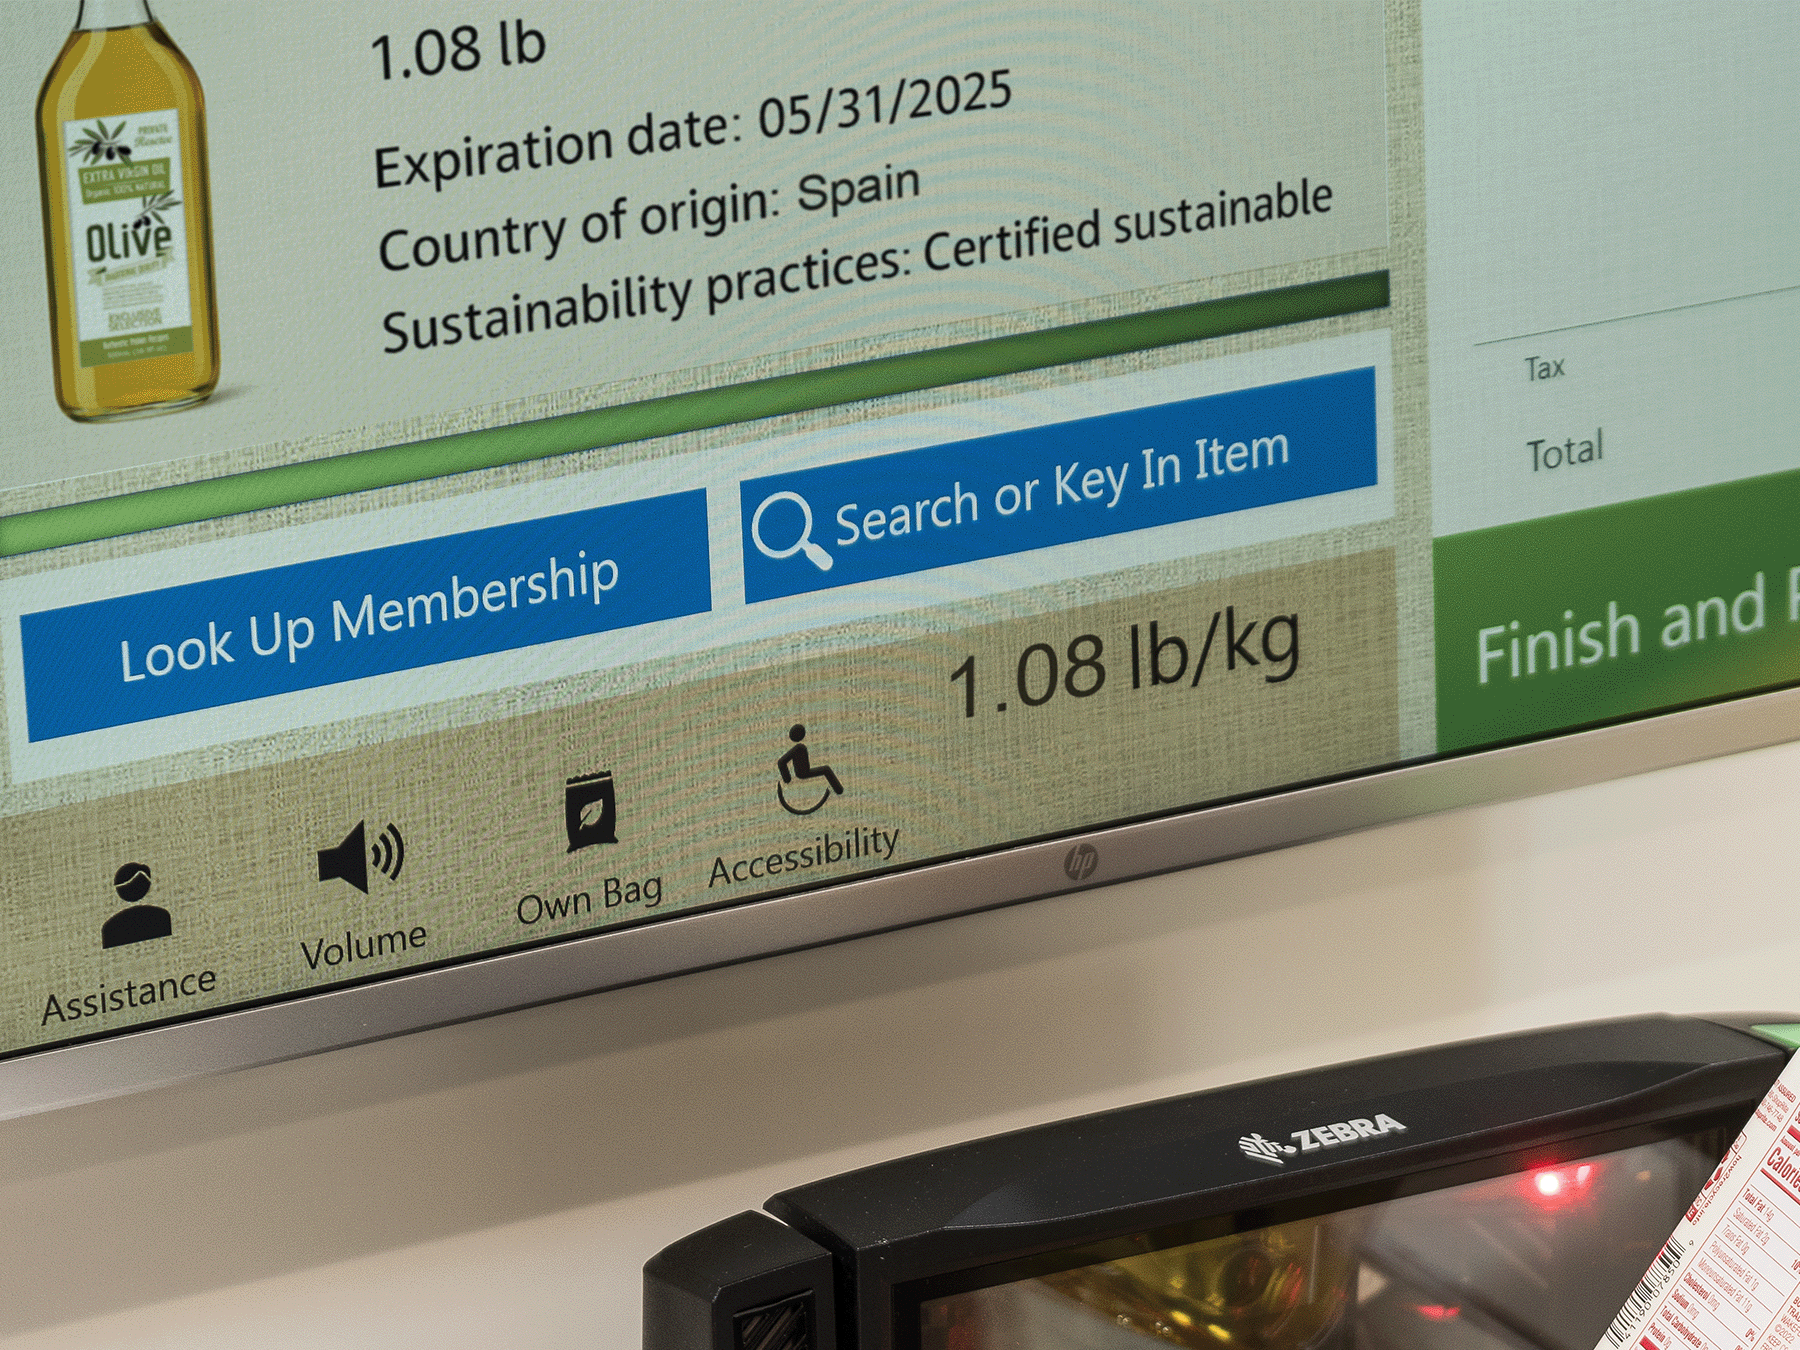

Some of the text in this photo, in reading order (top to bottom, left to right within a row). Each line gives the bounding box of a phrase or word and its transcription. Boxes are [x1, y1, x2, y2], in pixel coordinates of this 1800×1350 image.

[371, 19, 547, 80] 1.08 lb
[374, 69, 1012, 191] Expiration date: 05/31/2025
[379, 165, 920, 272] Country of origin: Spain
[86, 222, 172, 263] Olive
[382, 177, 1334, 355] Sustainability practices: Certified sustainable
[1525, 355, 1566, 382] Tax
[1526, 427, 1604, 472] Total
[836, 432, 1290, 546] Search or Key In Item
[120, 550, 621, 683] Look Up Membership
[1478, 601, 1642, 684] Finish
[1661, 571, 1766, 651] and
[949, 604, 1301, 719] 1.08 lb/kg
[708, 826, 900, 889] Accessibility
[517, 862, 664, 928] Own Bag
[301, 924, 428, 971] Volume
[40, 968, 218, 1027] Assistance
[1290, 1113, 1407, 1151] ZEBRA
[1692, 1154, 1742, 1226] how2recycle.info
[1742, 1188, 1774, 1223] Total Fat 14g
[1721, 1224, 1744, 1248] Trans Fat
[1732, 1207, 1756, 1232] Saturated
[1753, 1225, 1764, 1239] Fat
[1697, 1257, 1744, 1304] Monounsaturated Fat
[1708, 1240, 1753, 1284] Polyunsaturated Fat
[1625, 1301, 1652, 1339] 41190
[1650, 1259, 1680, 1298] 07850
[1671, 1288, 1690, 1310] Sodium
[1683, 1272, 1711, 1301] Cholesterol
[1648, 1322, 1666, 1343] Protein
[1660, 1305, 1703, 1349] Total Carbohydrate
[1745, 1328, 1756, 1342] 0%
